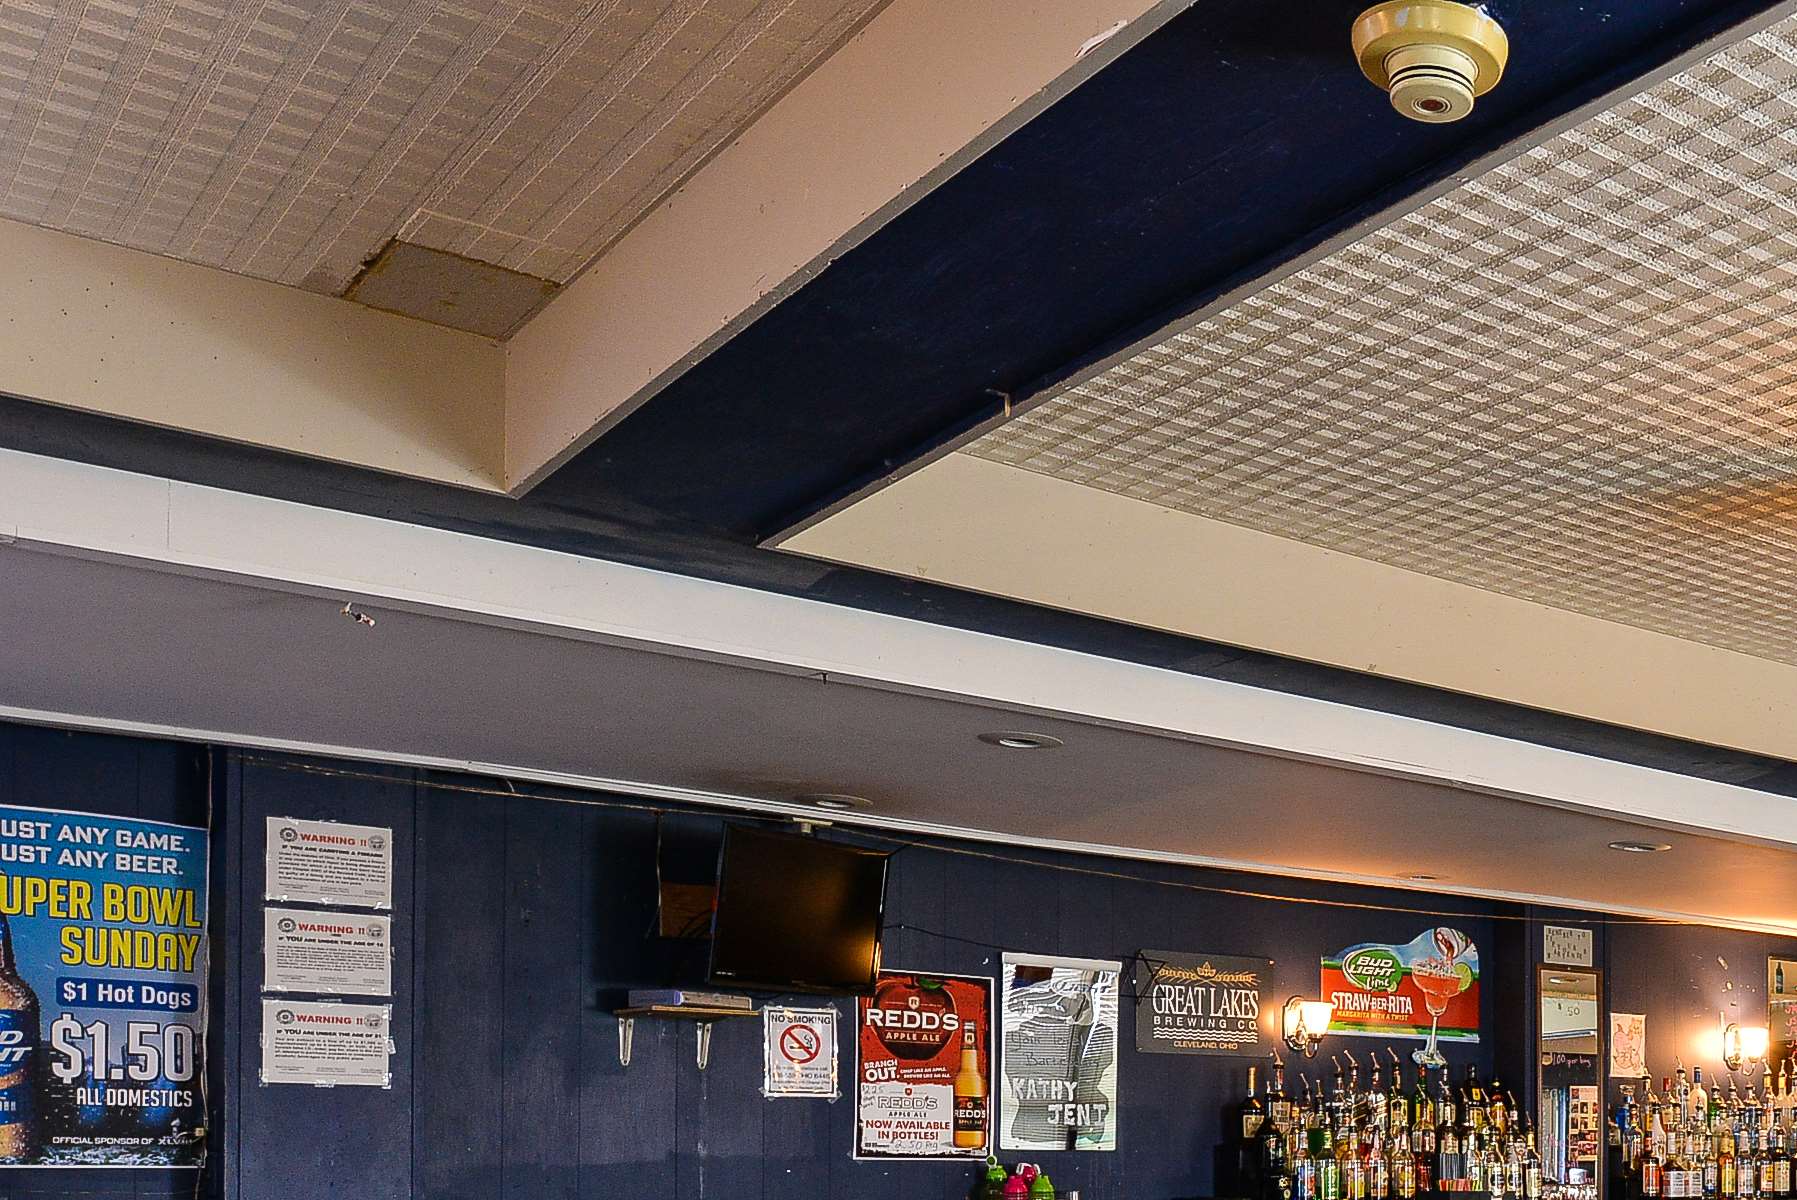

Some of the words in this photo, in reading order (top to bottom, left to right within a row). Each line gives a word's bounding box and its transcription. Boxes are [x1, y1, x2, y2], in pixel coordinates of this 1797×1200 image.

[0, 819, 51, 840] UST
[57, 825, 109, 845] ANY
[115, 829, 190, 852] GAME.
[300, 833, 355, 846] WARNING
[0, 844, 51, 864] UST
[57, 849, 109, 868] ANY
[115, 853, 183, 875] BEER.
[0, 874, 92, 920] UPER
[103, 883, 202, 927] BOWL
[298, 923, 353, 934] WARNING
[60, 925, 199, 972] SUNDAY
[1356, 956, 1393, 968] BUD
[1350, 964, 1396, 976] LIGHT
[1366, 976, 1389, 990] Lime
[63, 982, 87, 1002] $1
[98, 984, 135, 1003] Hot
[141, 986, 192, 1008] Dogs
[1152, 984, 1206, 1016] GREAT
[1209, 987, 1259, 1020] LAKES
[296, 1015, 352, 1025] WARNING
[771, 1014, 785, 1023] NO
[787, 1015, 831, 1025] SMOKING
[1153, 1015, 1227, 1029] BREWING
[1336, 1010, 1370, 1019] MARGARITA
[1371, 1012, 1385, 1020] WITH
[1391, 1013, 1409, 1021] TWIST
[885, 1032, 917, 1041] APPLE
[921, 1034, 940, 1042] ALE
[51, 1012, 195, 1084] $1.50
[1219, 1042, 1238, 1050] OHIO
[864, 1059, 898, 1069] BRANCH
[1012, 1077, 1078, 1101] KATHY
[76, 1088, 103, 1105] ALL
[106, 1088, 193, 1107] DOMESTICS
[1047, 1103, 1107, 1126] JENI
[866, 1119, 892, 1129] NOW
[895, 1120, 950, 1130] AVAILABLE
[52, 1136, 93, 1145] OFFICIAL
[94, 1137, 140, 1145] SPONSOR
[141, 1137, 154, 1145] OF
[878, 1131, 889, 1139] IN
[892, 1131, 939, 1140] BOTTLES!
